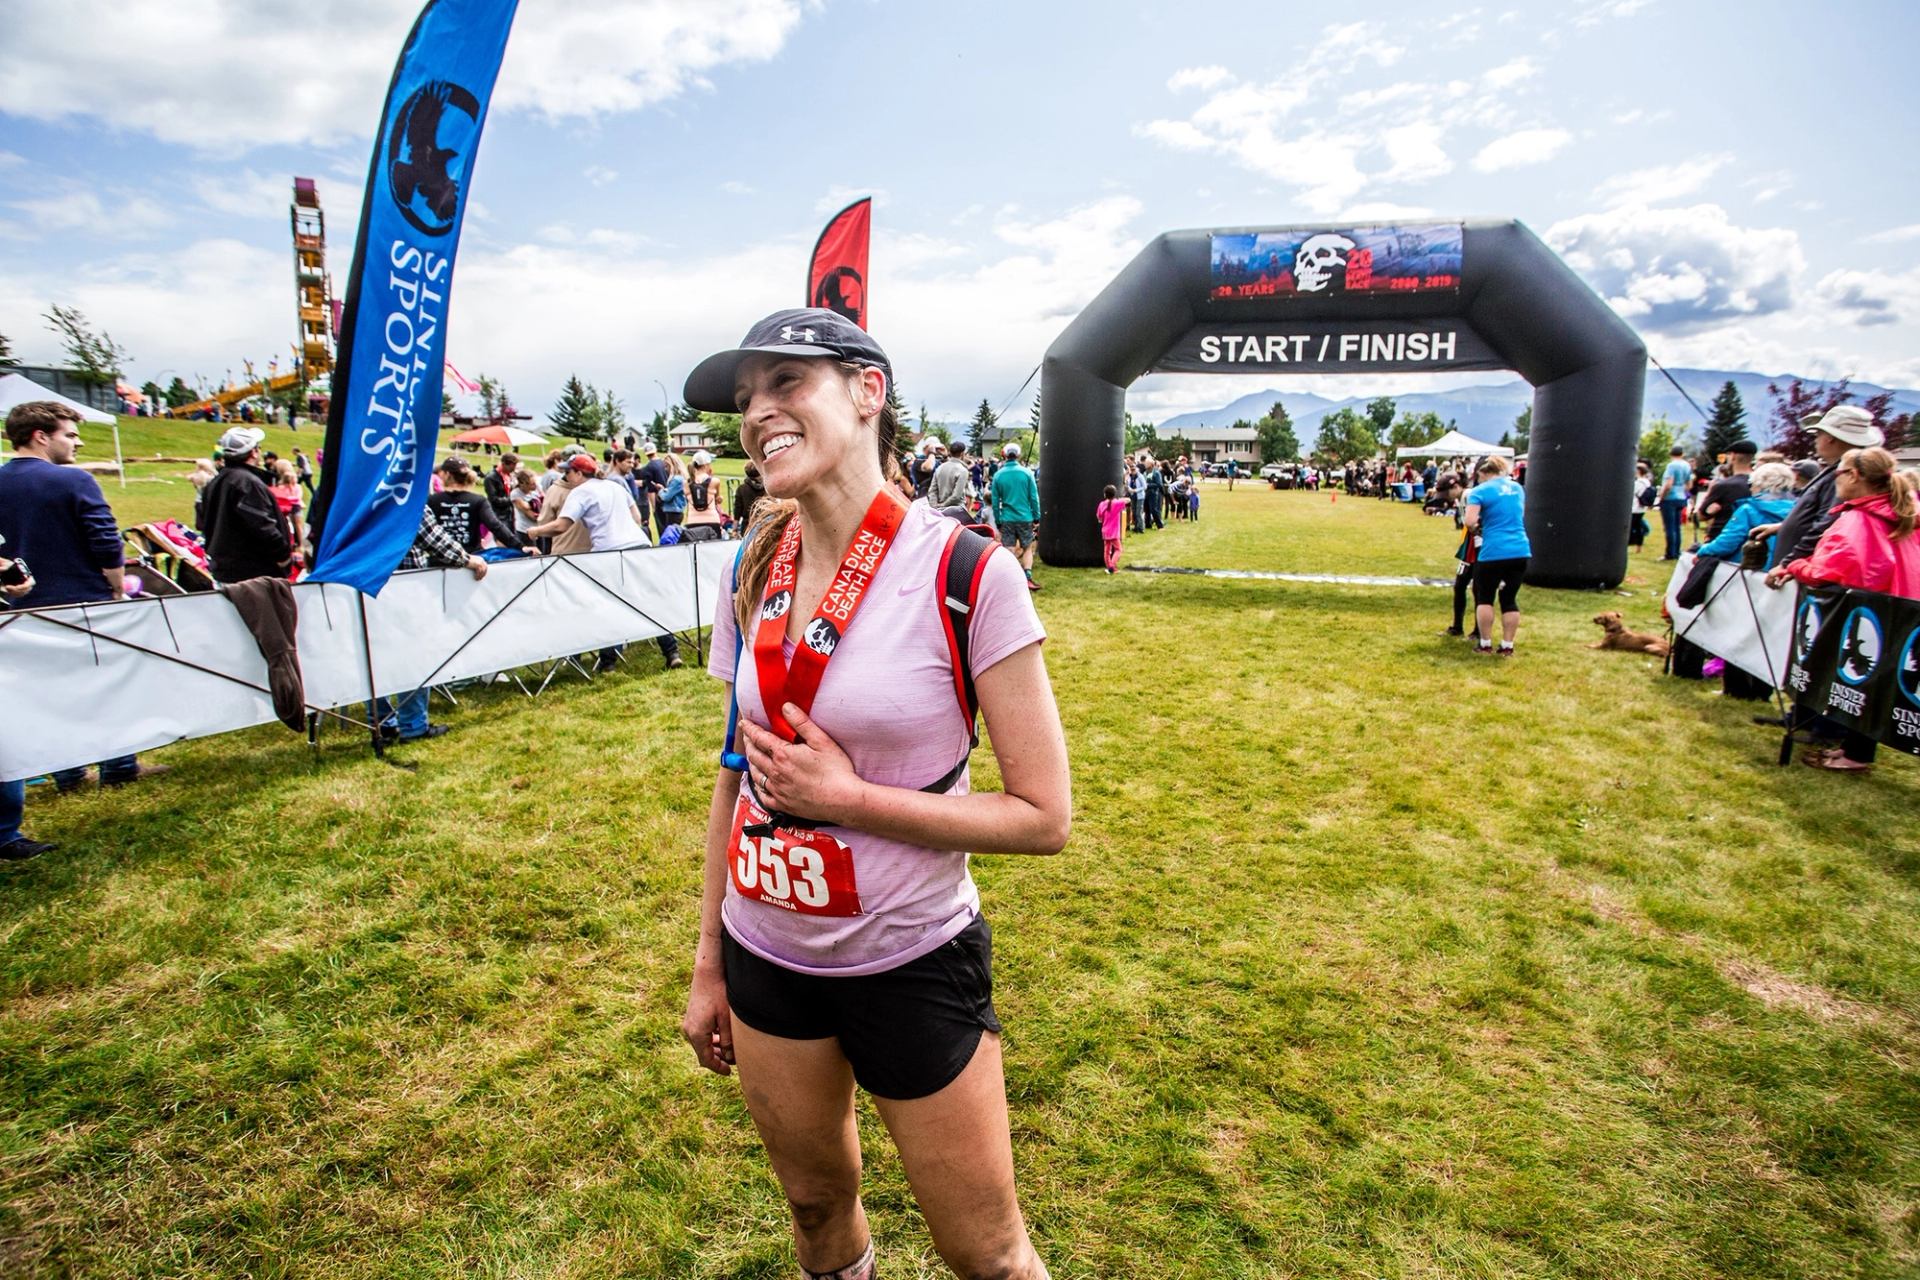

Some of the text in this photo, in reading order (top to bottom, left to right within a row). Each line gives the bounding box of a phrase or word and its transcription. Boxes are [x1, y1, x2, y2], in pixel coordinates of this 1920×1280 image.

[1238, 283, 1275, 297] YEARS
[1424, 273, 1453, 288] 2019
[360, 239, 423, 468] SPORTS
[1200, 335, 1311, 363] START
[1339, 331, 1457, 362] FINISH
[822, 529, 874, 614] CANADIAN
[834, 535, 887, 621] DEATH RACE
[737, 818, 830, 908] 553
[759, 893, 798, 912] AMANDA
